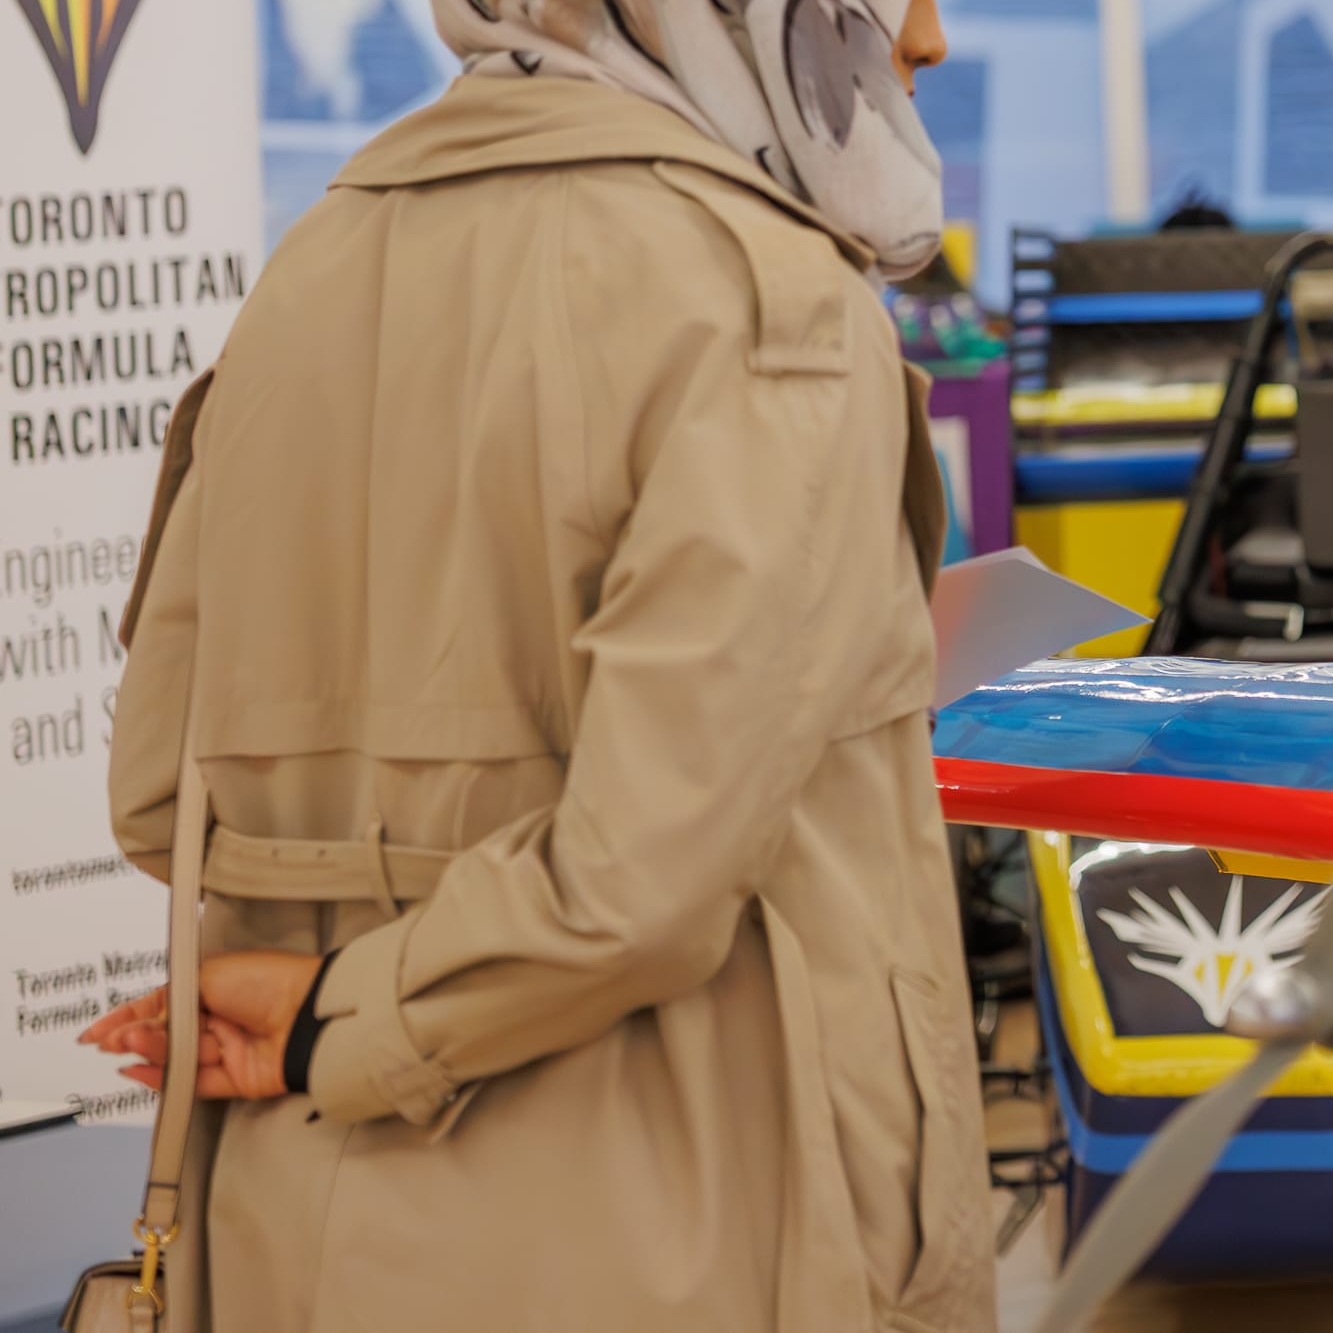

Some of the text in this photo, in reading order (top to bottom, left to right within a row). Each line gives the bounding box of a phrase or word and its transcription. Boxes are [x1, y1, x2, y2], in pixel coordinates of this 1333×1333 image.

[0, 188, 188, 246] ORONTO
[0, 329, 195, 390] ORMULA
[11, 401, 171, 462] RACING
[0, 529, 136, 607] nginee
[12, 694, 84, 764] and
